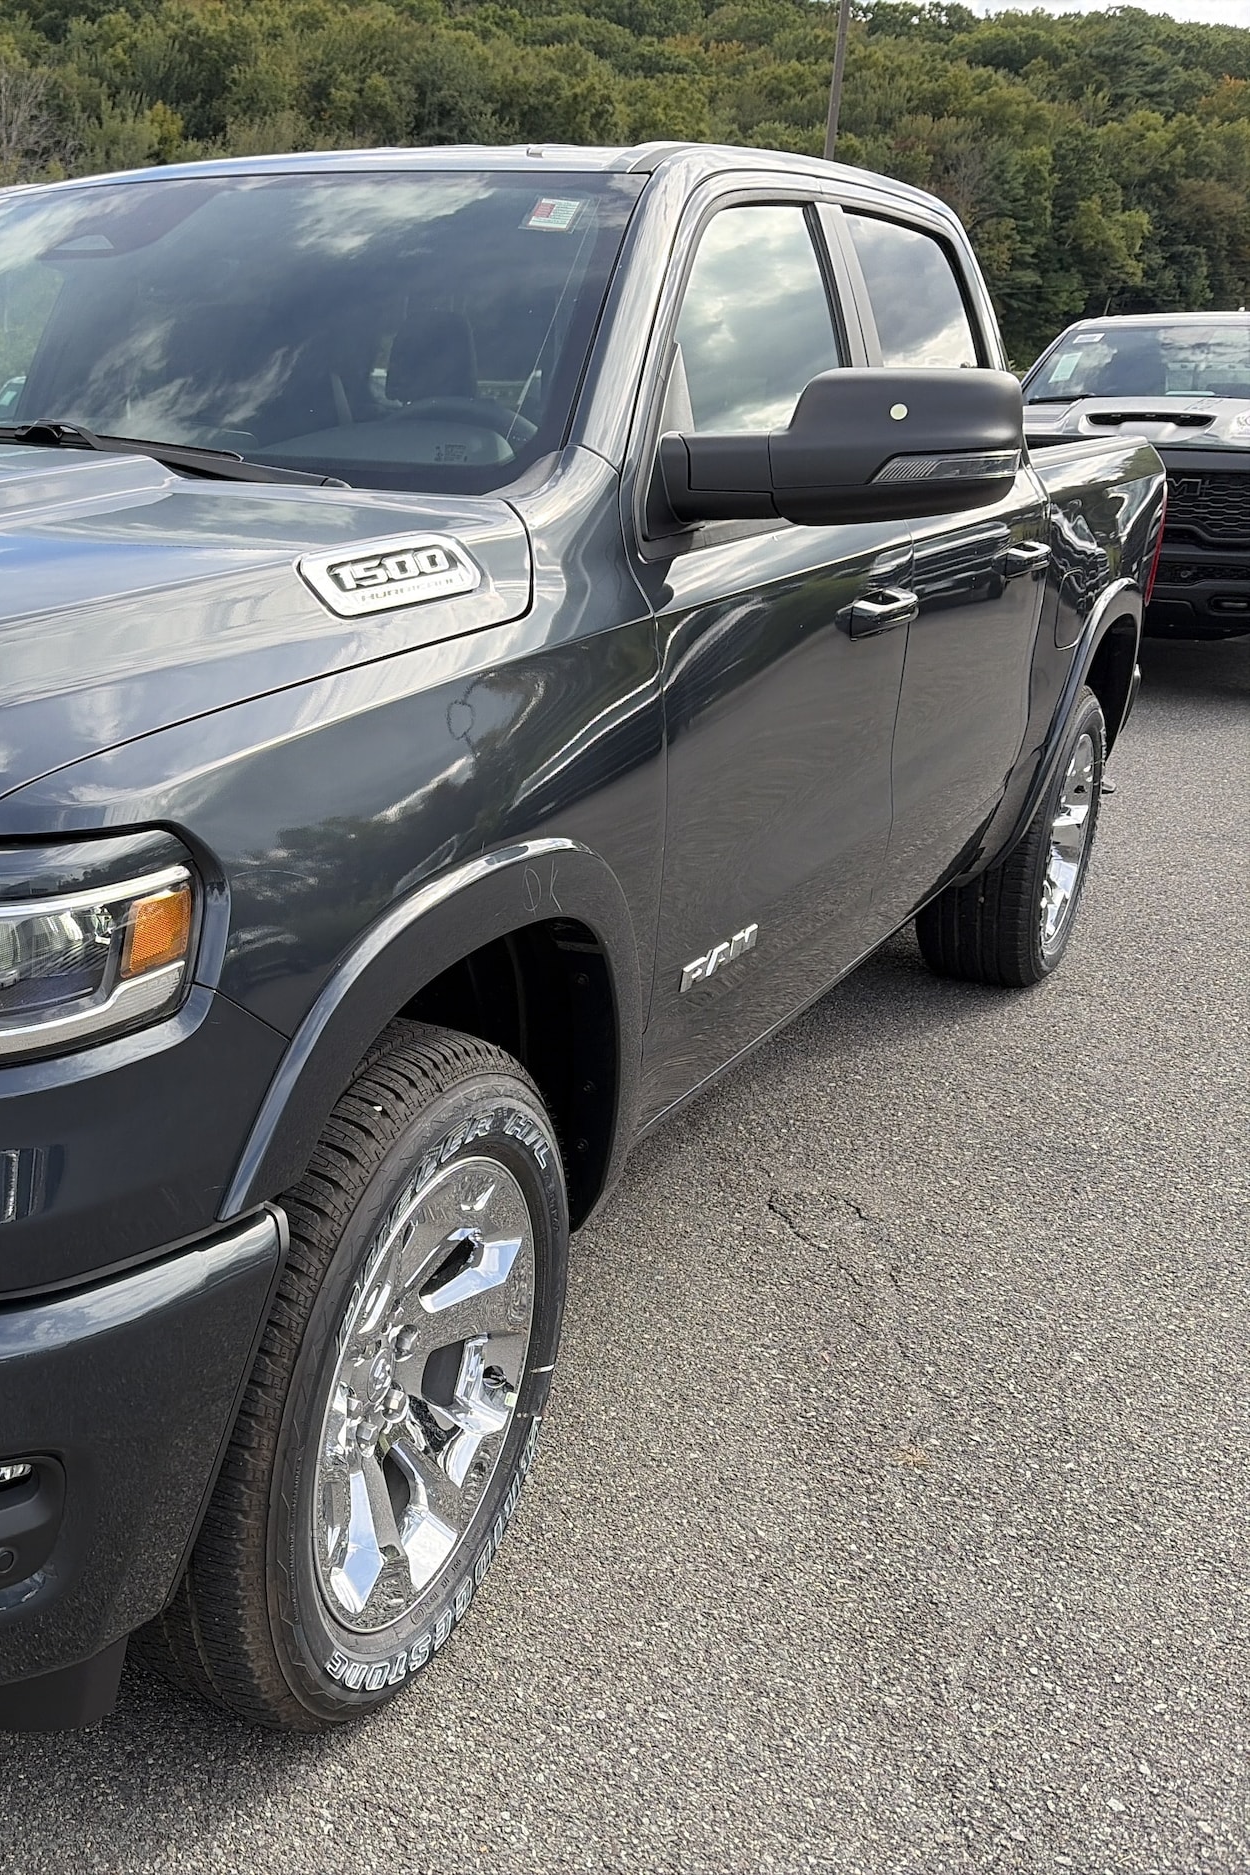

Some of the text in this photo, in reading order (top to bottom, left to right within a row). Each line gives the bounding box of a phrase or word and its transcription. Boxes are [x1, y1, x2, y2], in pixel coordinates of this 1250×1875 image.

[331, 548, 450, 590] 1500
[679, 923, 759, 993] RAM
[503, 1112, 550, 1170] H/L
